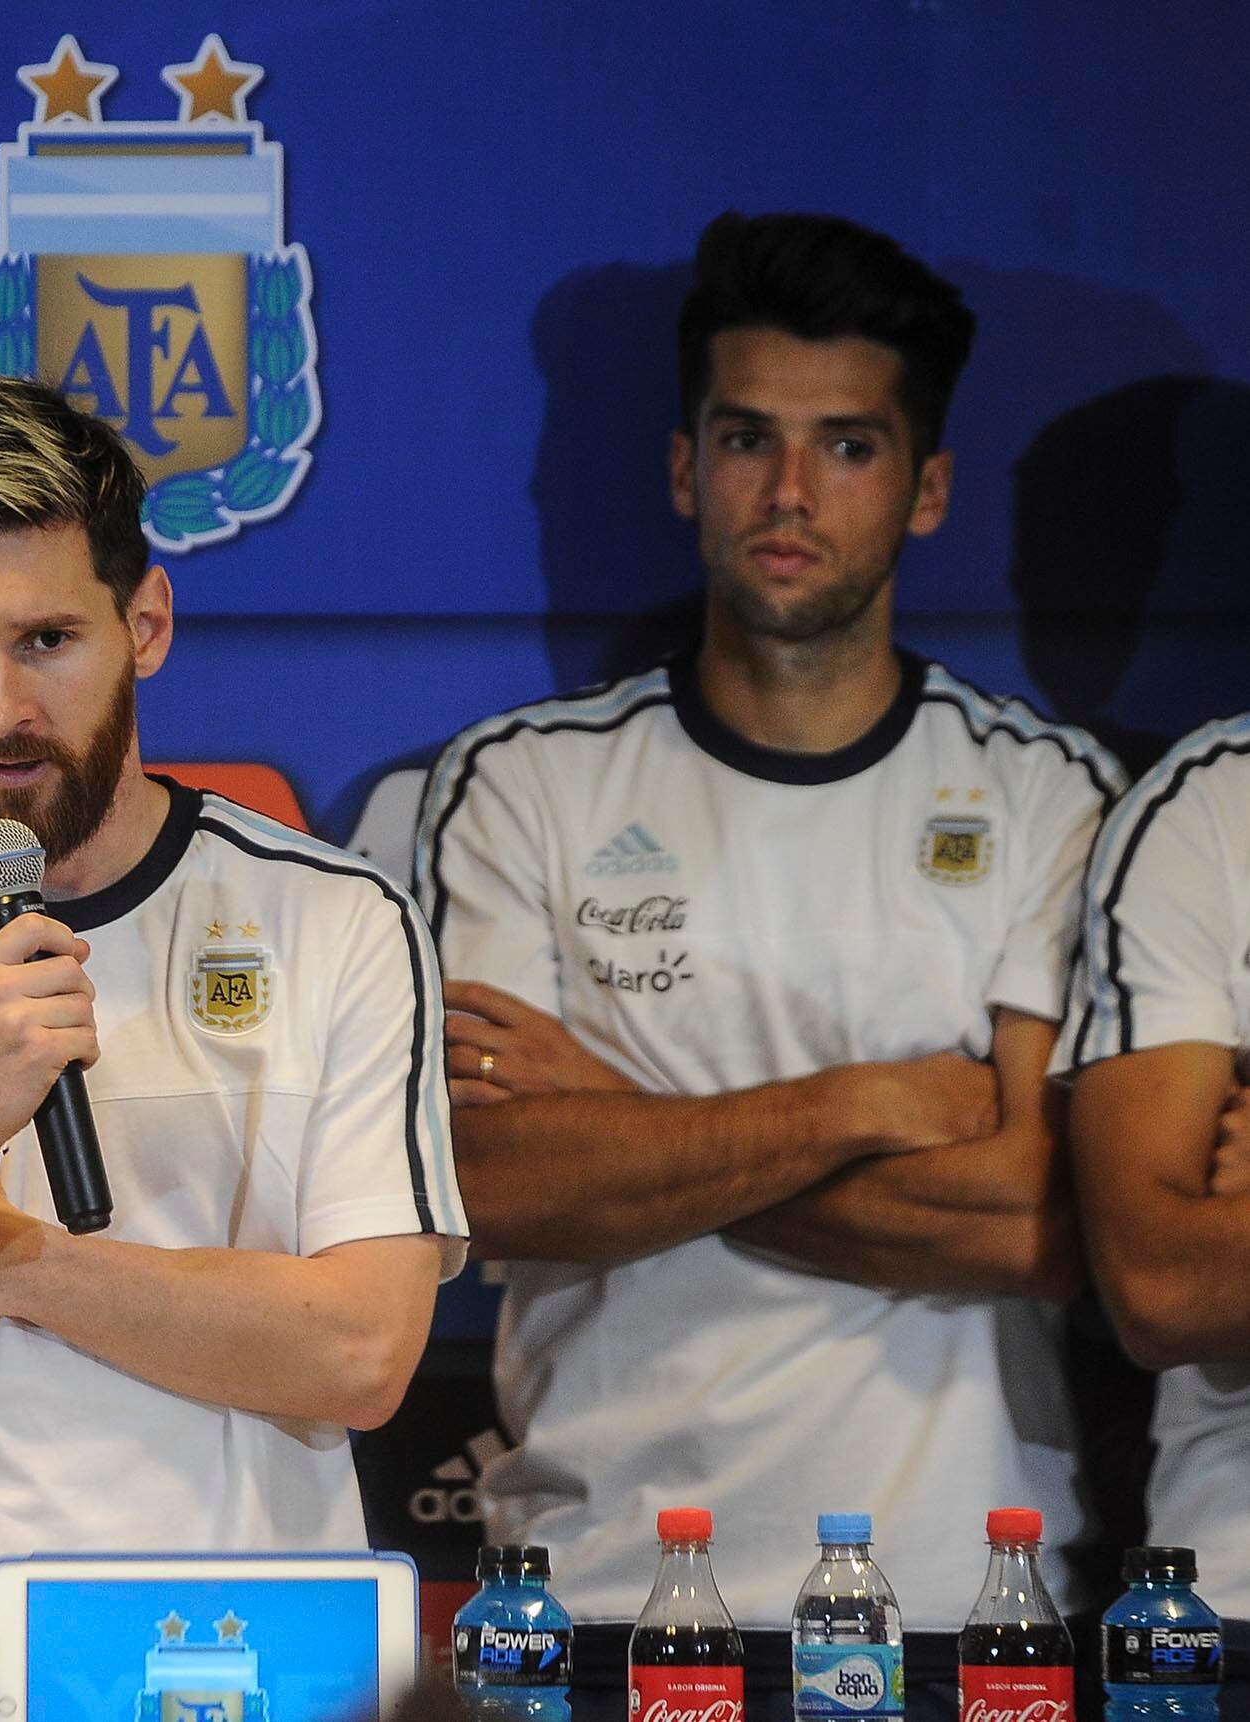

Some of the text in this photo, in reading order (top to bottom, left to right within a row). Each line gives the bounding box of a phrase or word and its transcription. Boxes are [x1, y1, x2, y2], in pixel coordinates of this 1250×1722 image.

[60, 271, 235, 458] AFA
[577, 895, 688, 935] Coca-Cola
[589, 957, 672, 992] Claro
[210, 972, 253, 1007] AFA
[480, 1630, 557, 1651] POWER
[1151, 1632, 1220, 1648] POWER
[839, 1668, 872, 1685] bon
[667, 1683, 727, 1692] SABOR ORIGINAL
[835, 1684, 878, 1699] aqua
